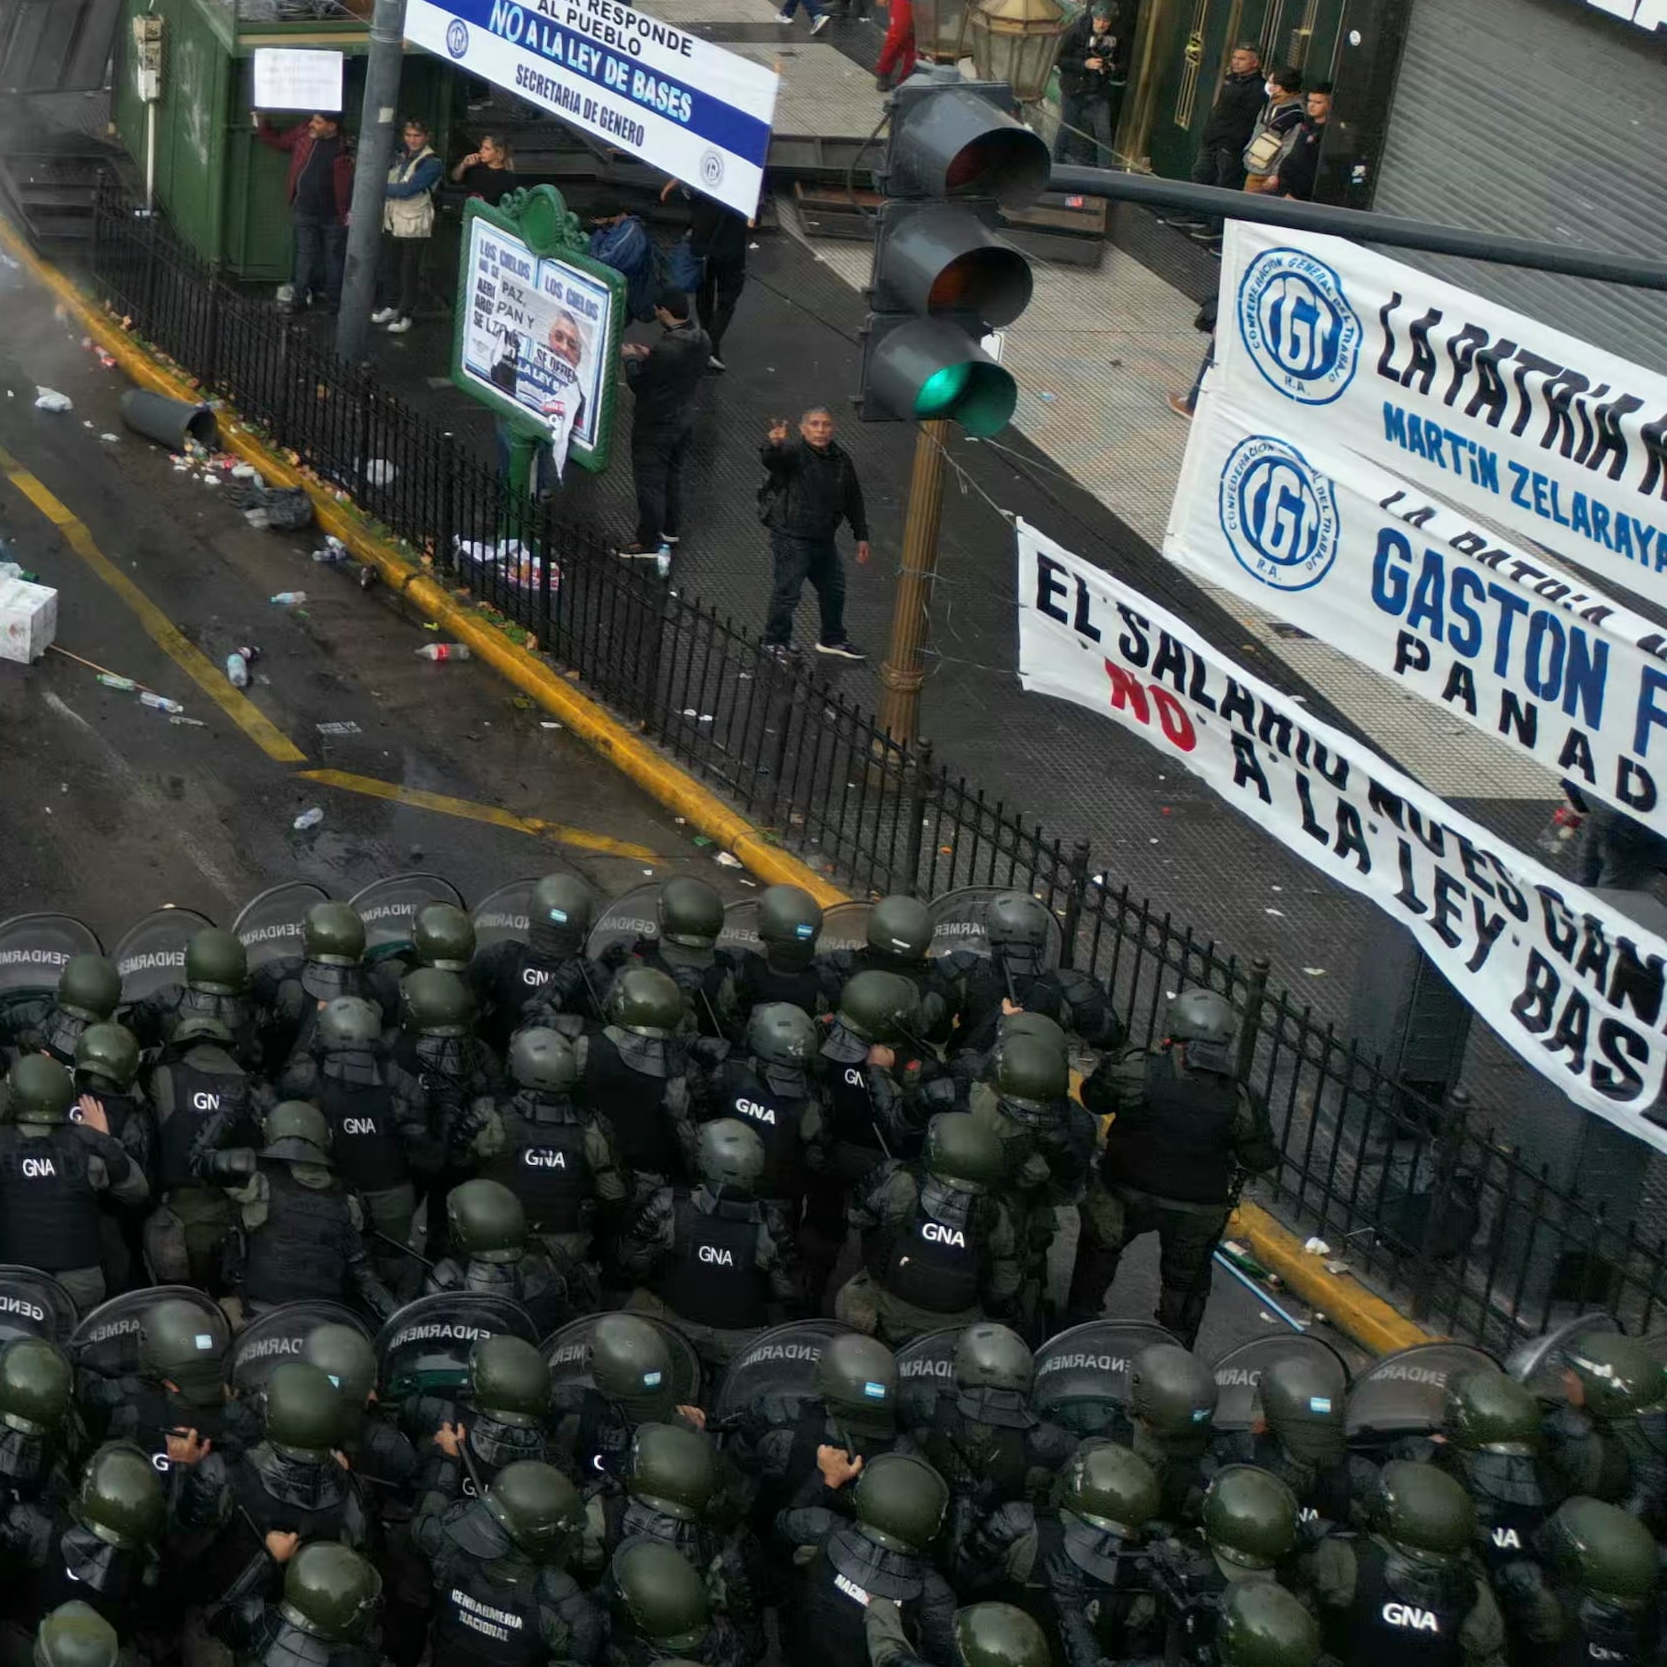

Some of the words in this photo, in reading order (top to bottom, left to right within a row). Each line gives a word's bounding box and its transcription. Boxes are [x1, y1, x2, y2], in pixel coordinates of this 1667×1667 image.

[566, 10, 643, 57] PUEBLO
[526, 20, 538, 47] A
[541, 26, 563, 60] LA
[567, 41, 600, 77] LEY
[605, 59, 628, 92] DE
[632, 71, 692, 123] BASES
[583, 98, 600, 122] DE
[600, 105, 645, 147] GENERO
[479, 238, 496, 260] LOS
[499, 246, 531, 281] CIELOS
[496, 301, 524, 324] PAN
[545, 275, 563, 299] LOS
[566, 284, 599, 321] CIELOS
[1378, 291, 1443, 396] LA
[1036, 551, 1102, 644] EL
[1372, 526, 1610, 732] GASTON
[1104, 657, 1197, 753] NO
[1231, 734, 1272, 805] A
[1296, 769, 1372, 875] LA
[1394, 836, 1507, 974] LEY
[343, 1117, 376, 1135] GNA
[735, 1097, 777, 1125] GNA
[22, 1158, 55, 1176] GNA
[524, 1149, 566, 1167] GNA
[698, 1245, 734, 1266] GNA
[921, 1223, 966, 1248] GNA
[452, 1589, 524, 1630] GENDARMERIA
[458, 1611, 510, 1641] NACIONAL
[1383, 1603, 1438, 1632] GNA
